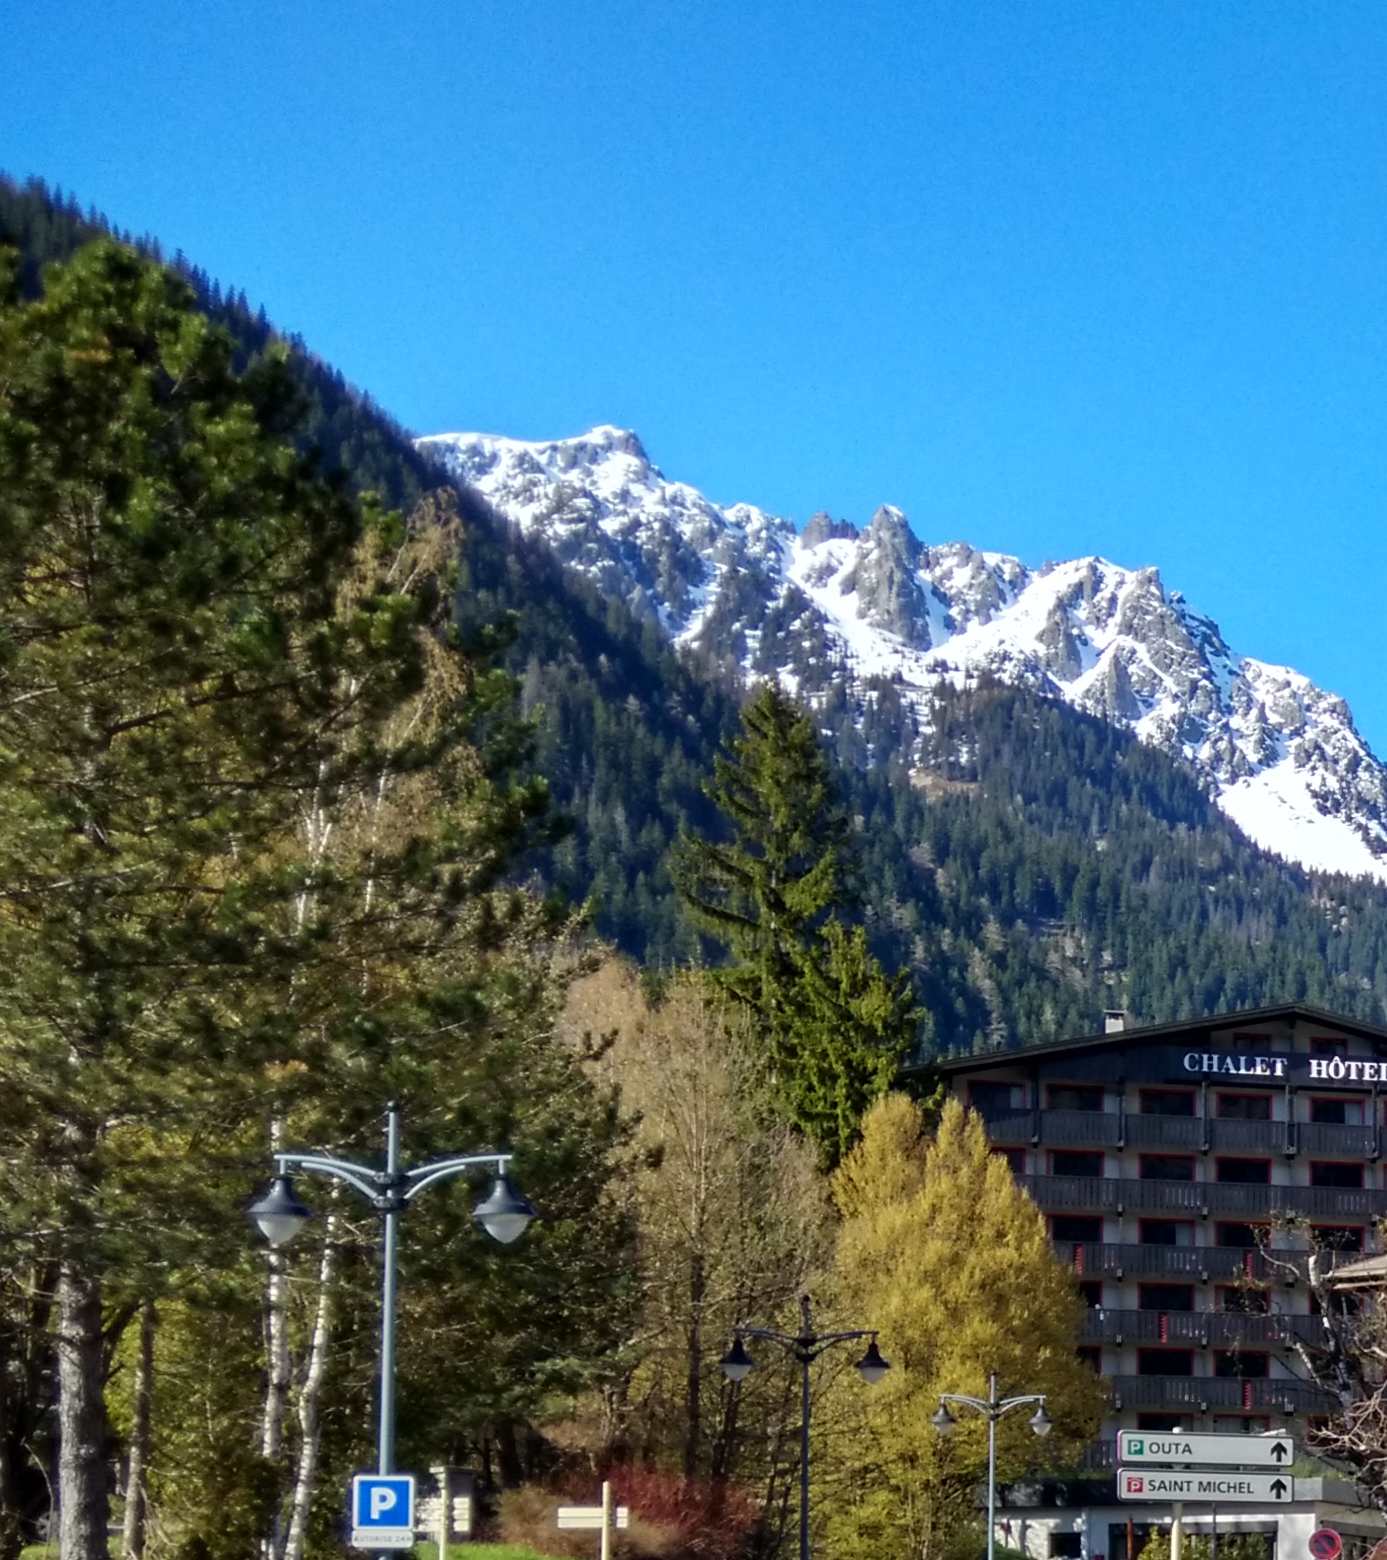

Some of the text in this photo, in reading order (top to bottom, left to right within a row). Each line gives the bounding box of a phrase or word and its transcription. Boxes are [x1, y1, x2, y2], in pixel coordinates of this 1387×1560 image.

[1183, 1052, 1288, 1077] CHALET
[1148, 1441, 1193, 1455] OUTA
[1148, 1479, 1193, 1493] SAINT
[1197, 1480, 1254, 1495] MICHEL
[370, 1486, 397, 1520] P
